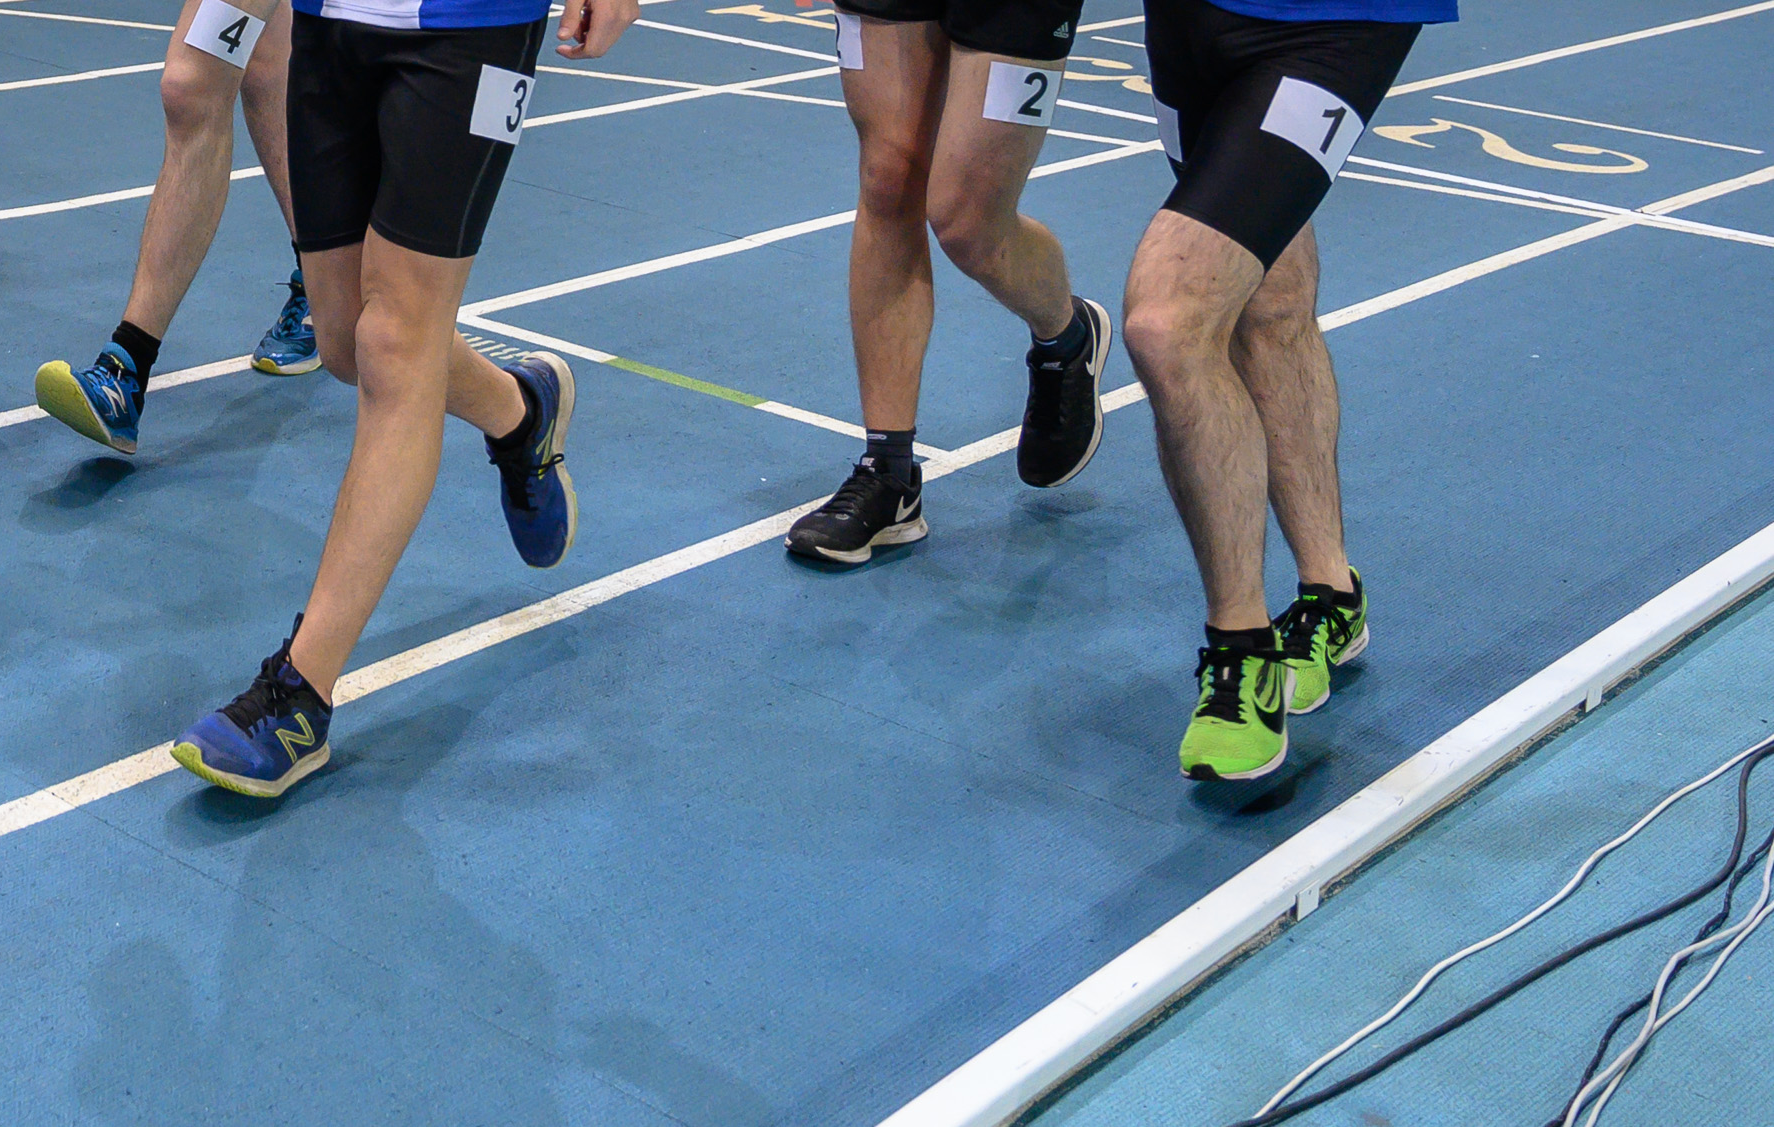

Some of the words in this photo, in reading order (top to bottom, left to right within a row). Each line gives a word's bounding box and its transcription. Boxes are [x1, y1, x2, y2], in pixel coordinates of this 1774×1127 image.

[217, 14, 250, 55] 4
[506, 78, 528, 133] 3
[1017, 71, 1048, 118] 2
[1321, 107, 1347, 154] 1
